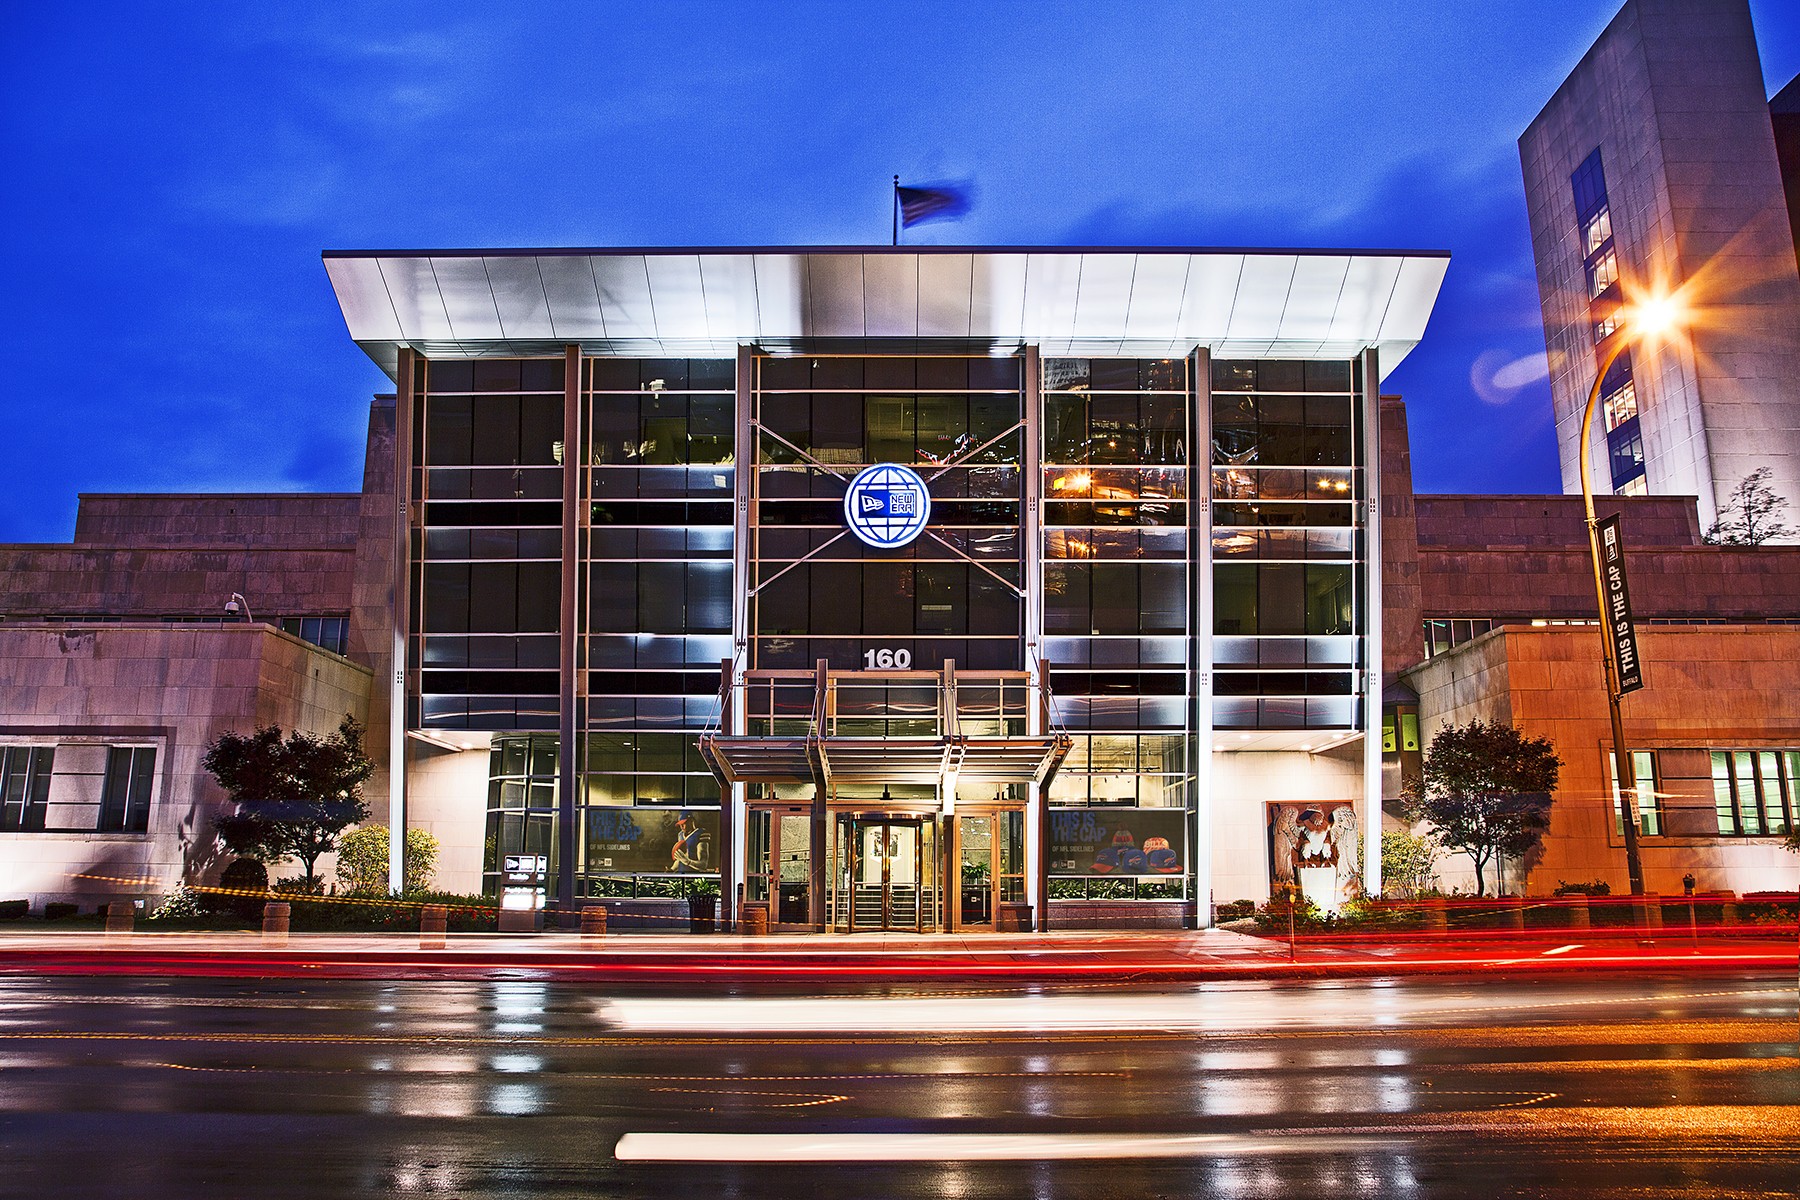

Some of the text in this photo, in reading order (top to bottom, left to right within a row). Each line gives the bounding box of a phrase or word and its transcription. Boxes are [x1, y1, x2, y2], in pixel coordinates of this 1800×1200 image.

[891, 495, 913, 504] NEW
[891, 504, 913, 512] ERA
[1608, 565, 1635, 674] THIS IS THE CAP
[864, 648, 911, 669] 160
[620, 812, 631, 826] IS
[1051, 812, 1095, 827] THIS IS
[591, 826, 641, 840] THE CAP
[1053, 826, 1106, 842] THE CAP
